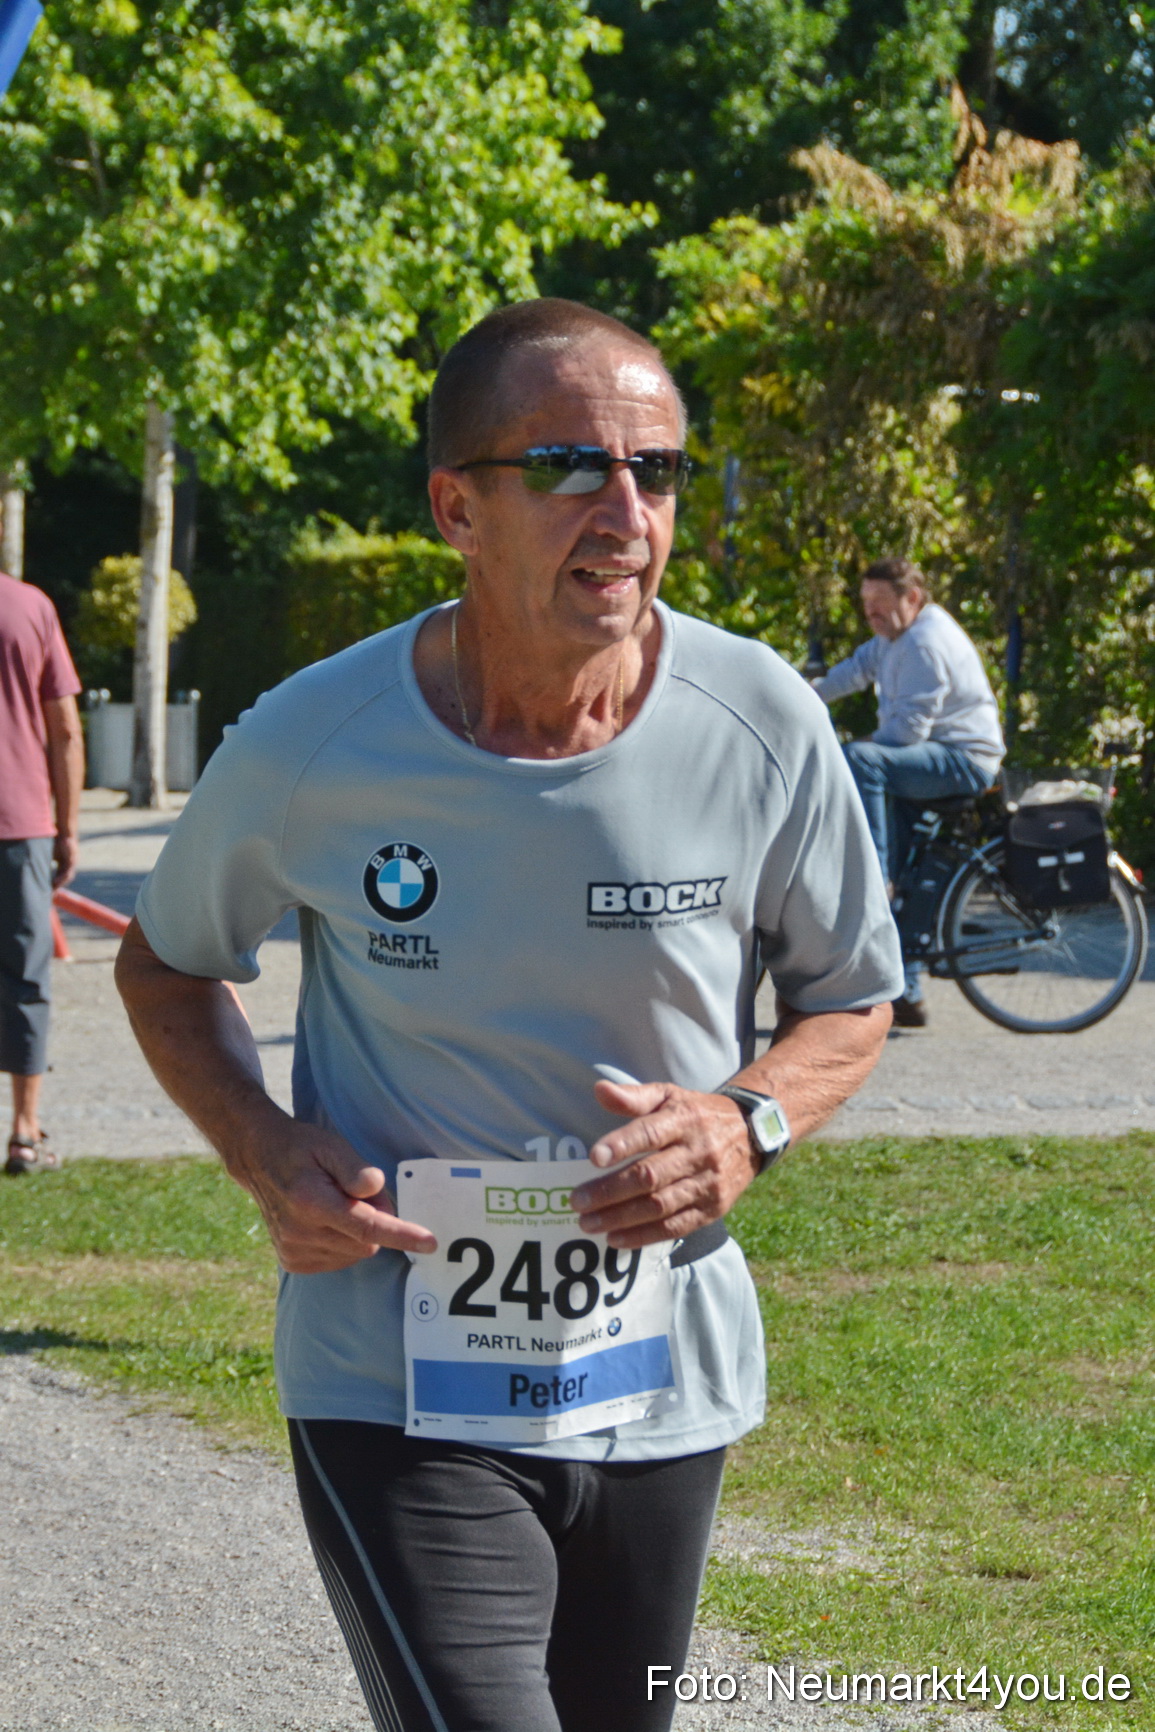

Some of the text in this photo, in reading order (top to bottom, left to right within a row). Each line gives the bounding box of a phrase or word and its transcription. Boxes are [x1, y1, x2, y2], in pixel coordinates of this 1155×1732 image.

[370, 844, 433, 871] BMW
[587, 876, 728, 916] BOCK
[587, 918, 636, 931] inspired
[639, 919, 654, 931] by
[368, 931, 440, 955] PARTL
[368, 948, 440, 970] Neumarkt
[485, 1186, 578, 1215] BOC
[486, 1216, 525, 1225] inspired
[527, 1216, 539, 1227] by
[541, 1216, 571, 1225] smart
[447, 1237, 643, 1320] 2489
[467, 1327, 603, 1352] PARTL Neumarkt
[509, 1371, 588, 1408] Peter
